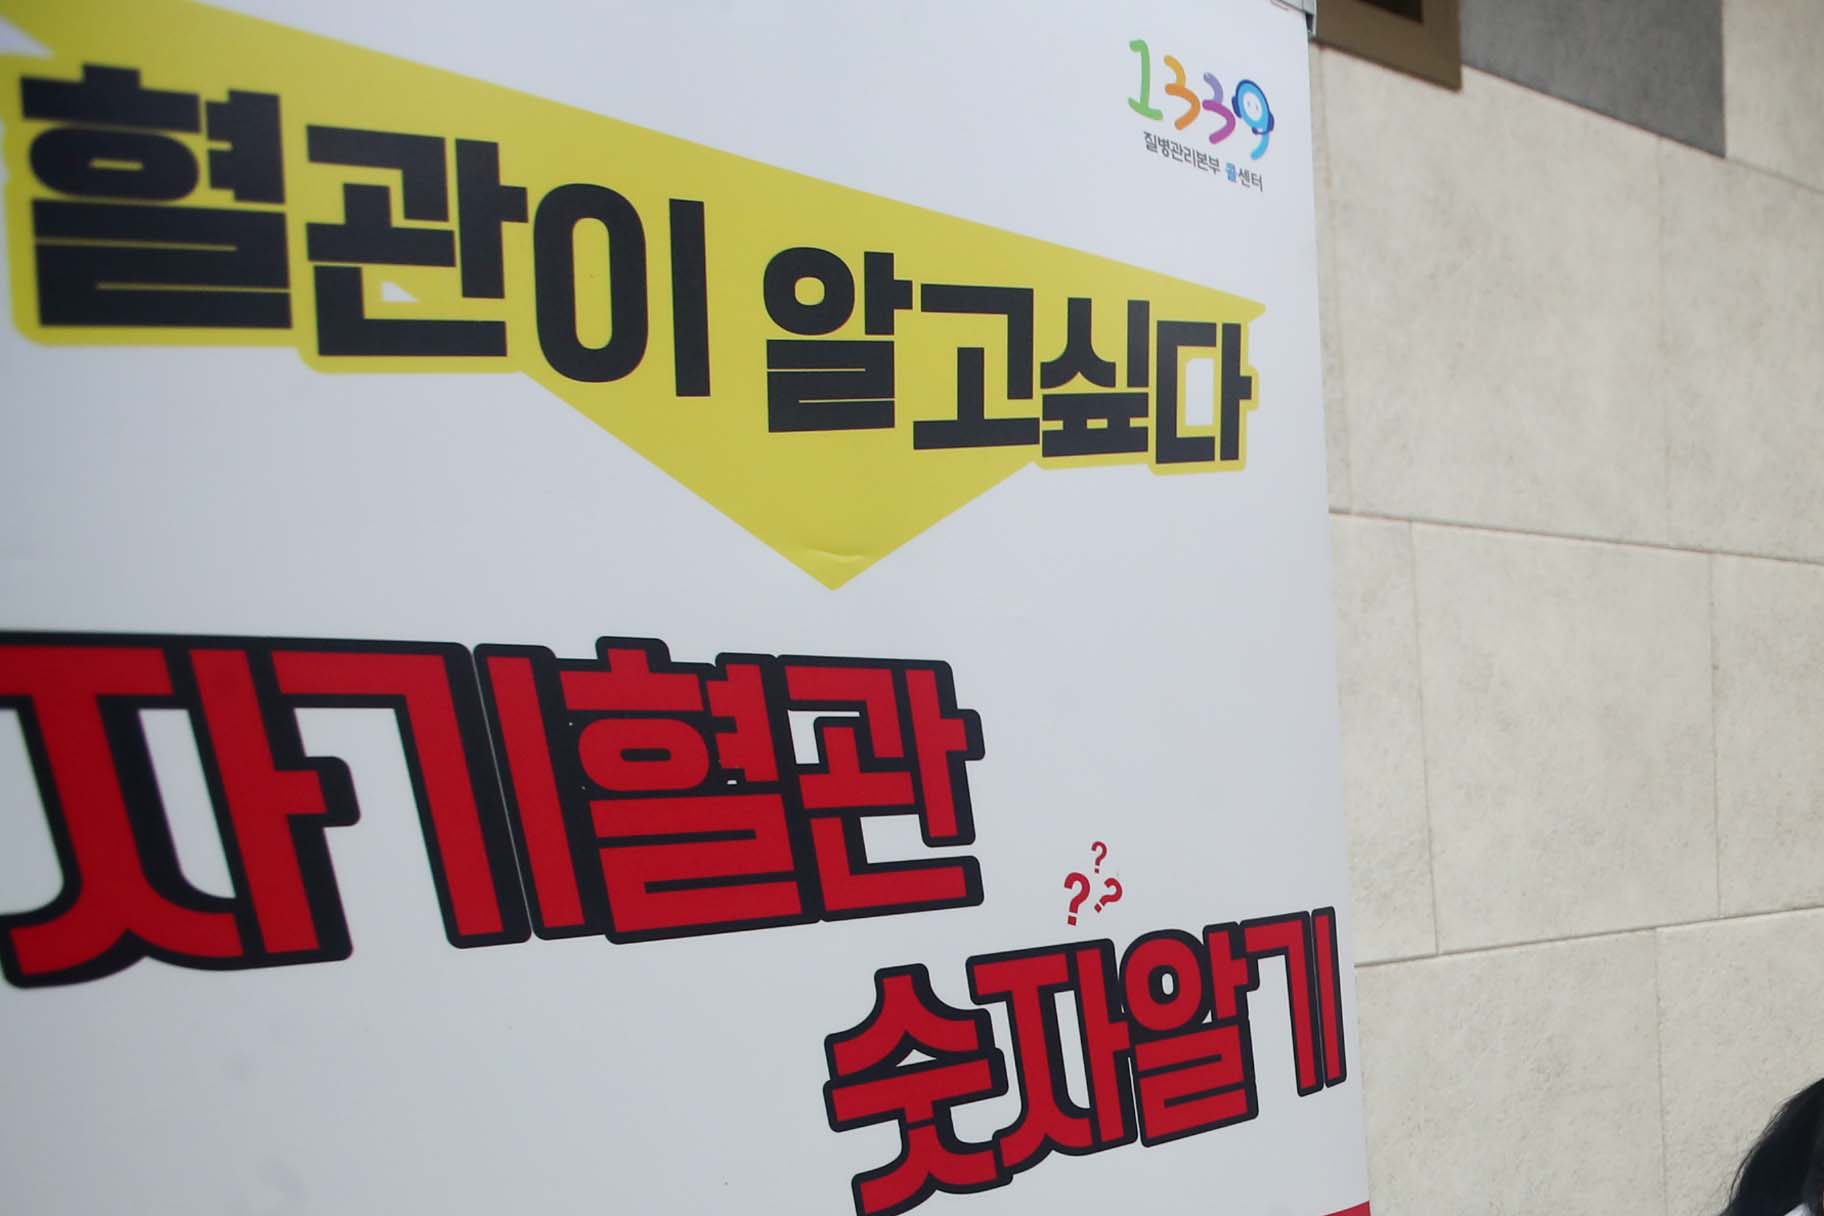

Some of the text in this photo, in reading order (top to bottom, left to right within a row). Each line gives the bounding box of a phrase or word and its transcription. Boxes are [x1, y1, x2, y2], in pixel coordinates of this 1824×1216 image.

[1127, 38, 1275, 161] 1339
[1143, 130, 1221, 175] 질병관리본부
[20, 62, 1252, 466] 혈관이 알고싶다
[0, 631, 986, 990] 자기혈관
